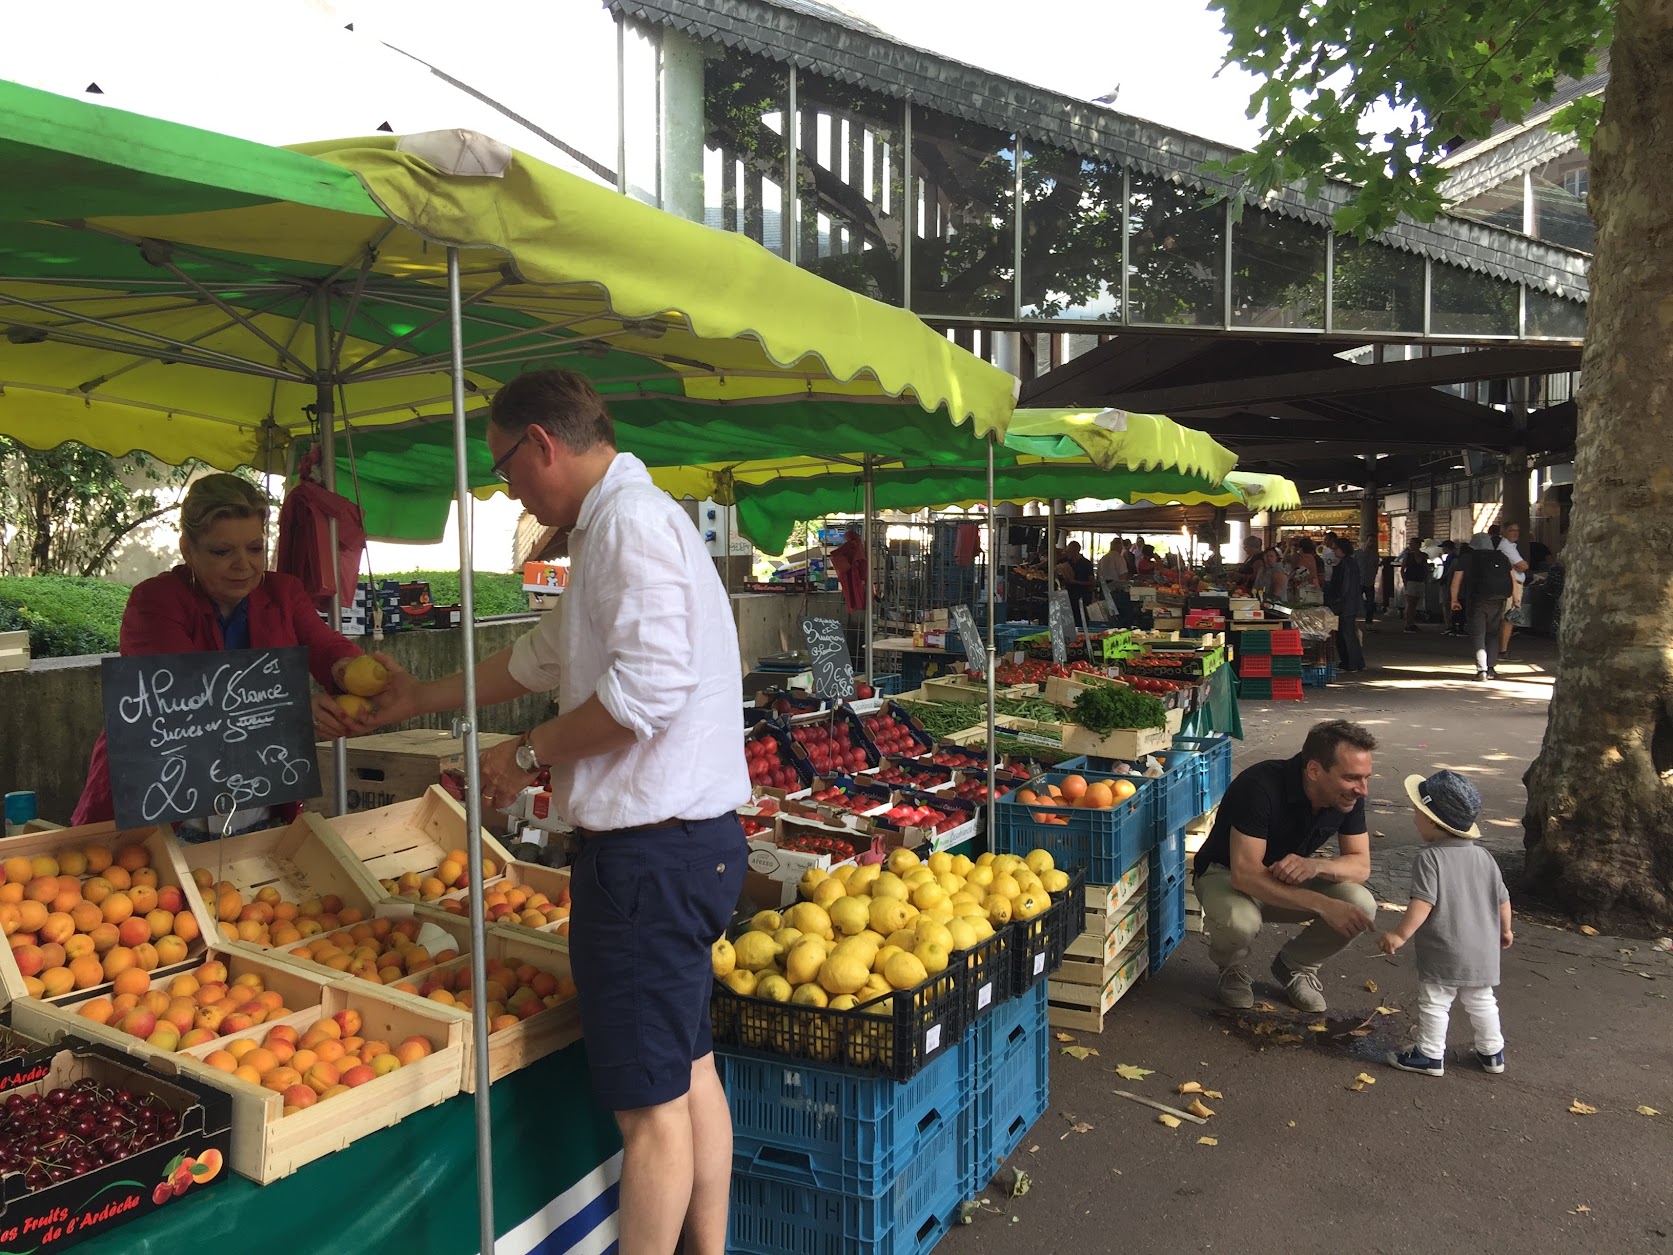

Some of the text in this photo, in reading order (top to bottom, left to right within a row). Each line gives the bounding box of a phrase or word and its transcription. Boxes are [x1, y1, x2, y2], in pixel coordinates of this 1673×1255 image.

[1279, 510, 1343, 524] Les Saveurs
[222, 652, 289, 711] France
[751, 858, 774, 867] arezzo
[0, 1065, 49, 1089] l'Ardèc
[0, 1207, 69, 1243] es Fruits
[41, 1195, 141, 1245] de l'Ardèche
